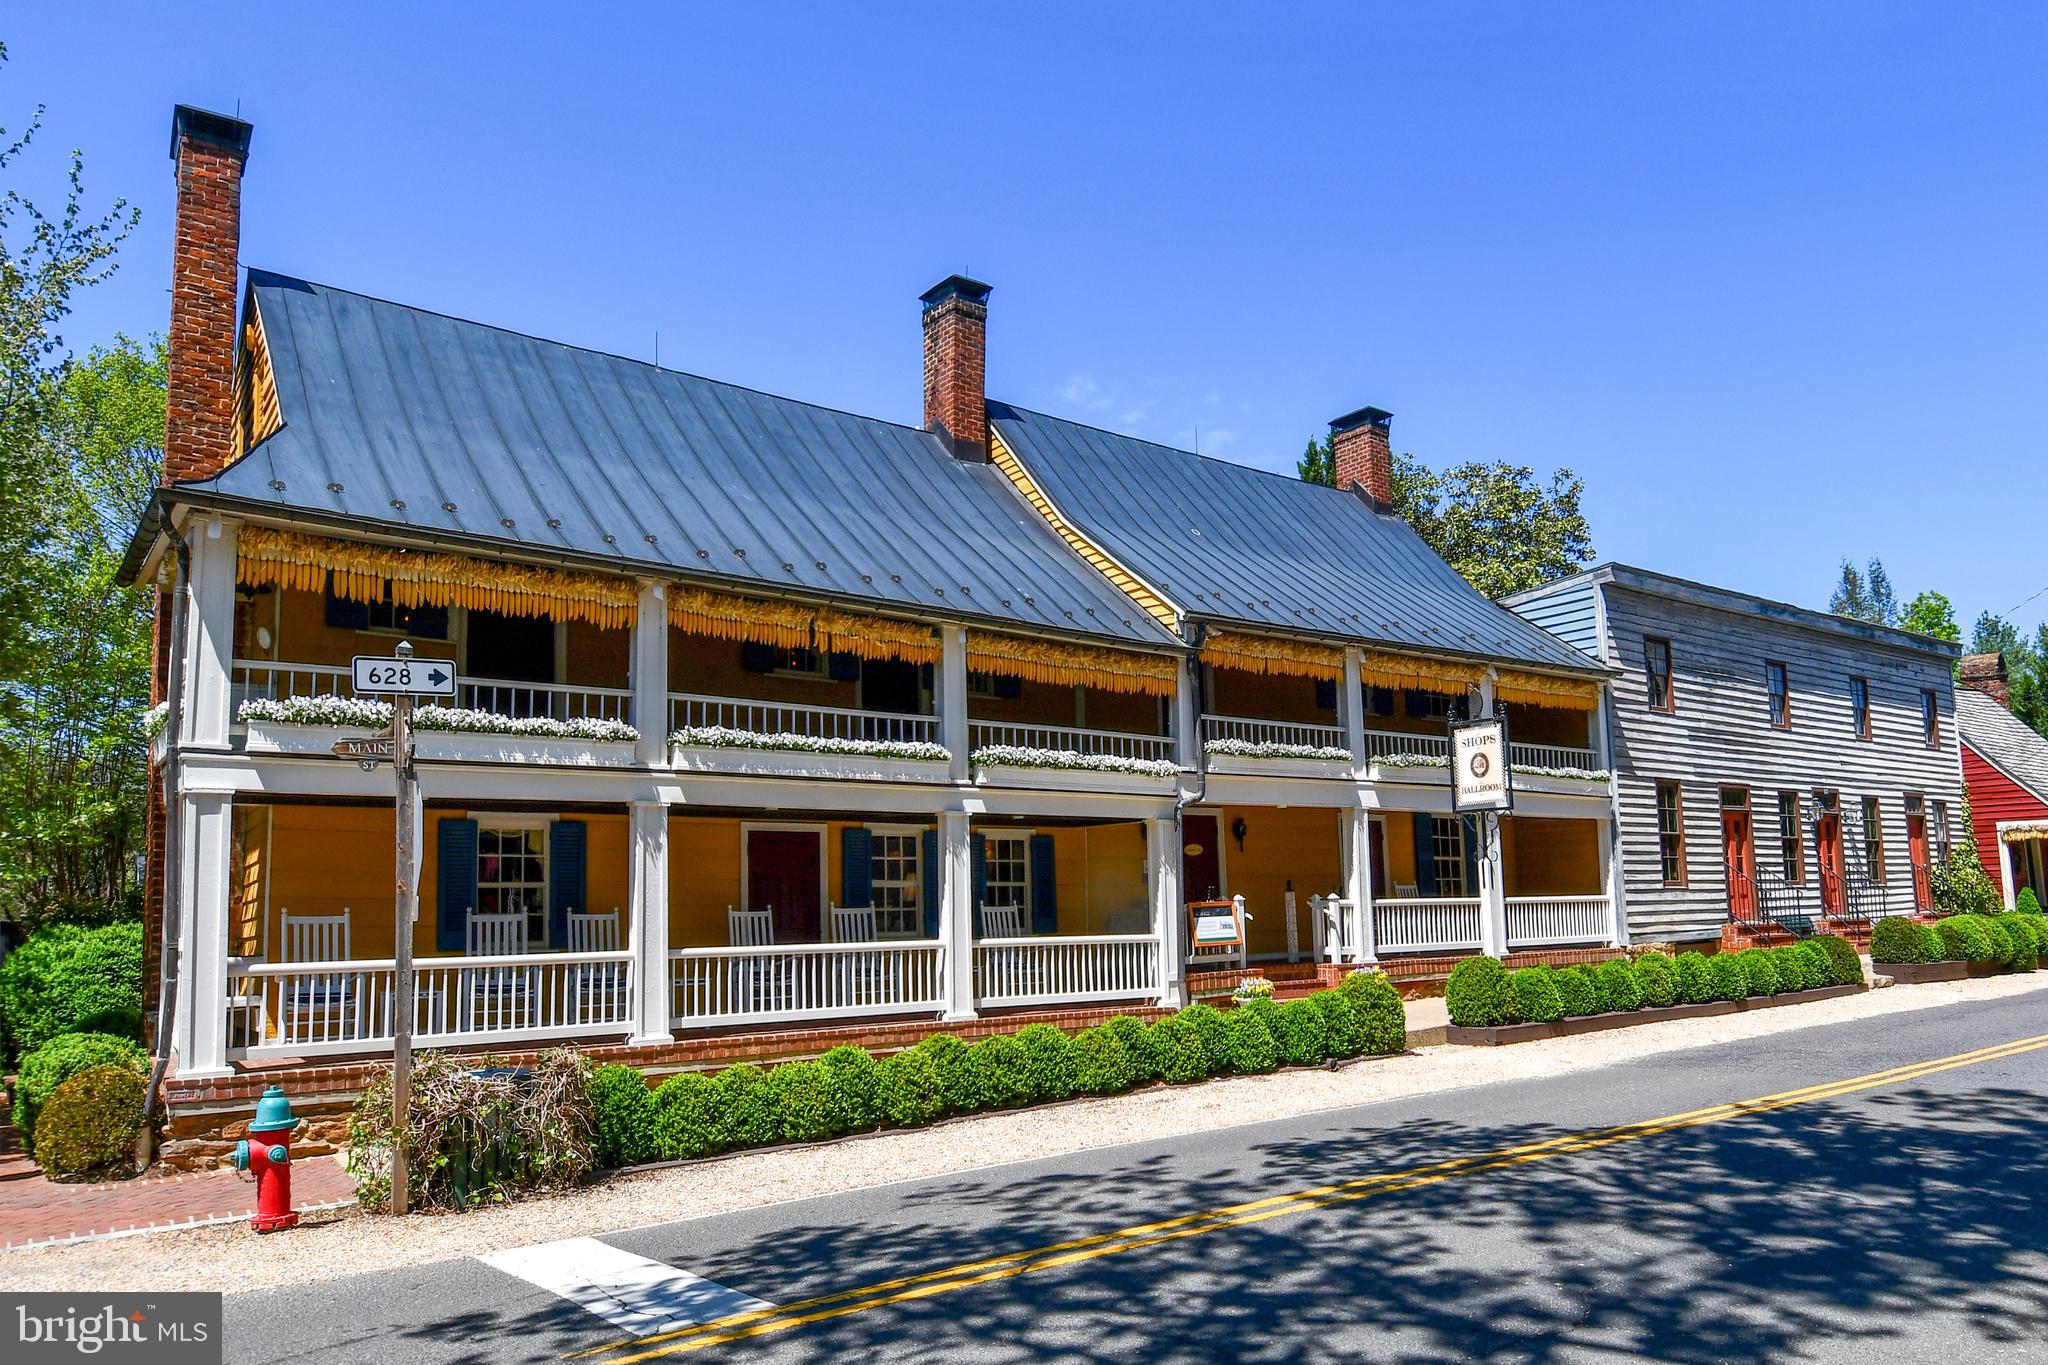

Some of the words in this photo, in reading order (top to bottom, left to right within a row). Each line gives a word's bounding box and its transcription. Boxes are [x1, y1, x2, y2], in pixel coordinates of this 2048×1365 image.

[369, 667, 411, 686] 628
[1460, 734, 1497, 748] SHOPS
[348, 743, 388, 754] MAIN
[362, 760, 376, 770] ST
[1461, 783, 1503, 795] BALLROOM
